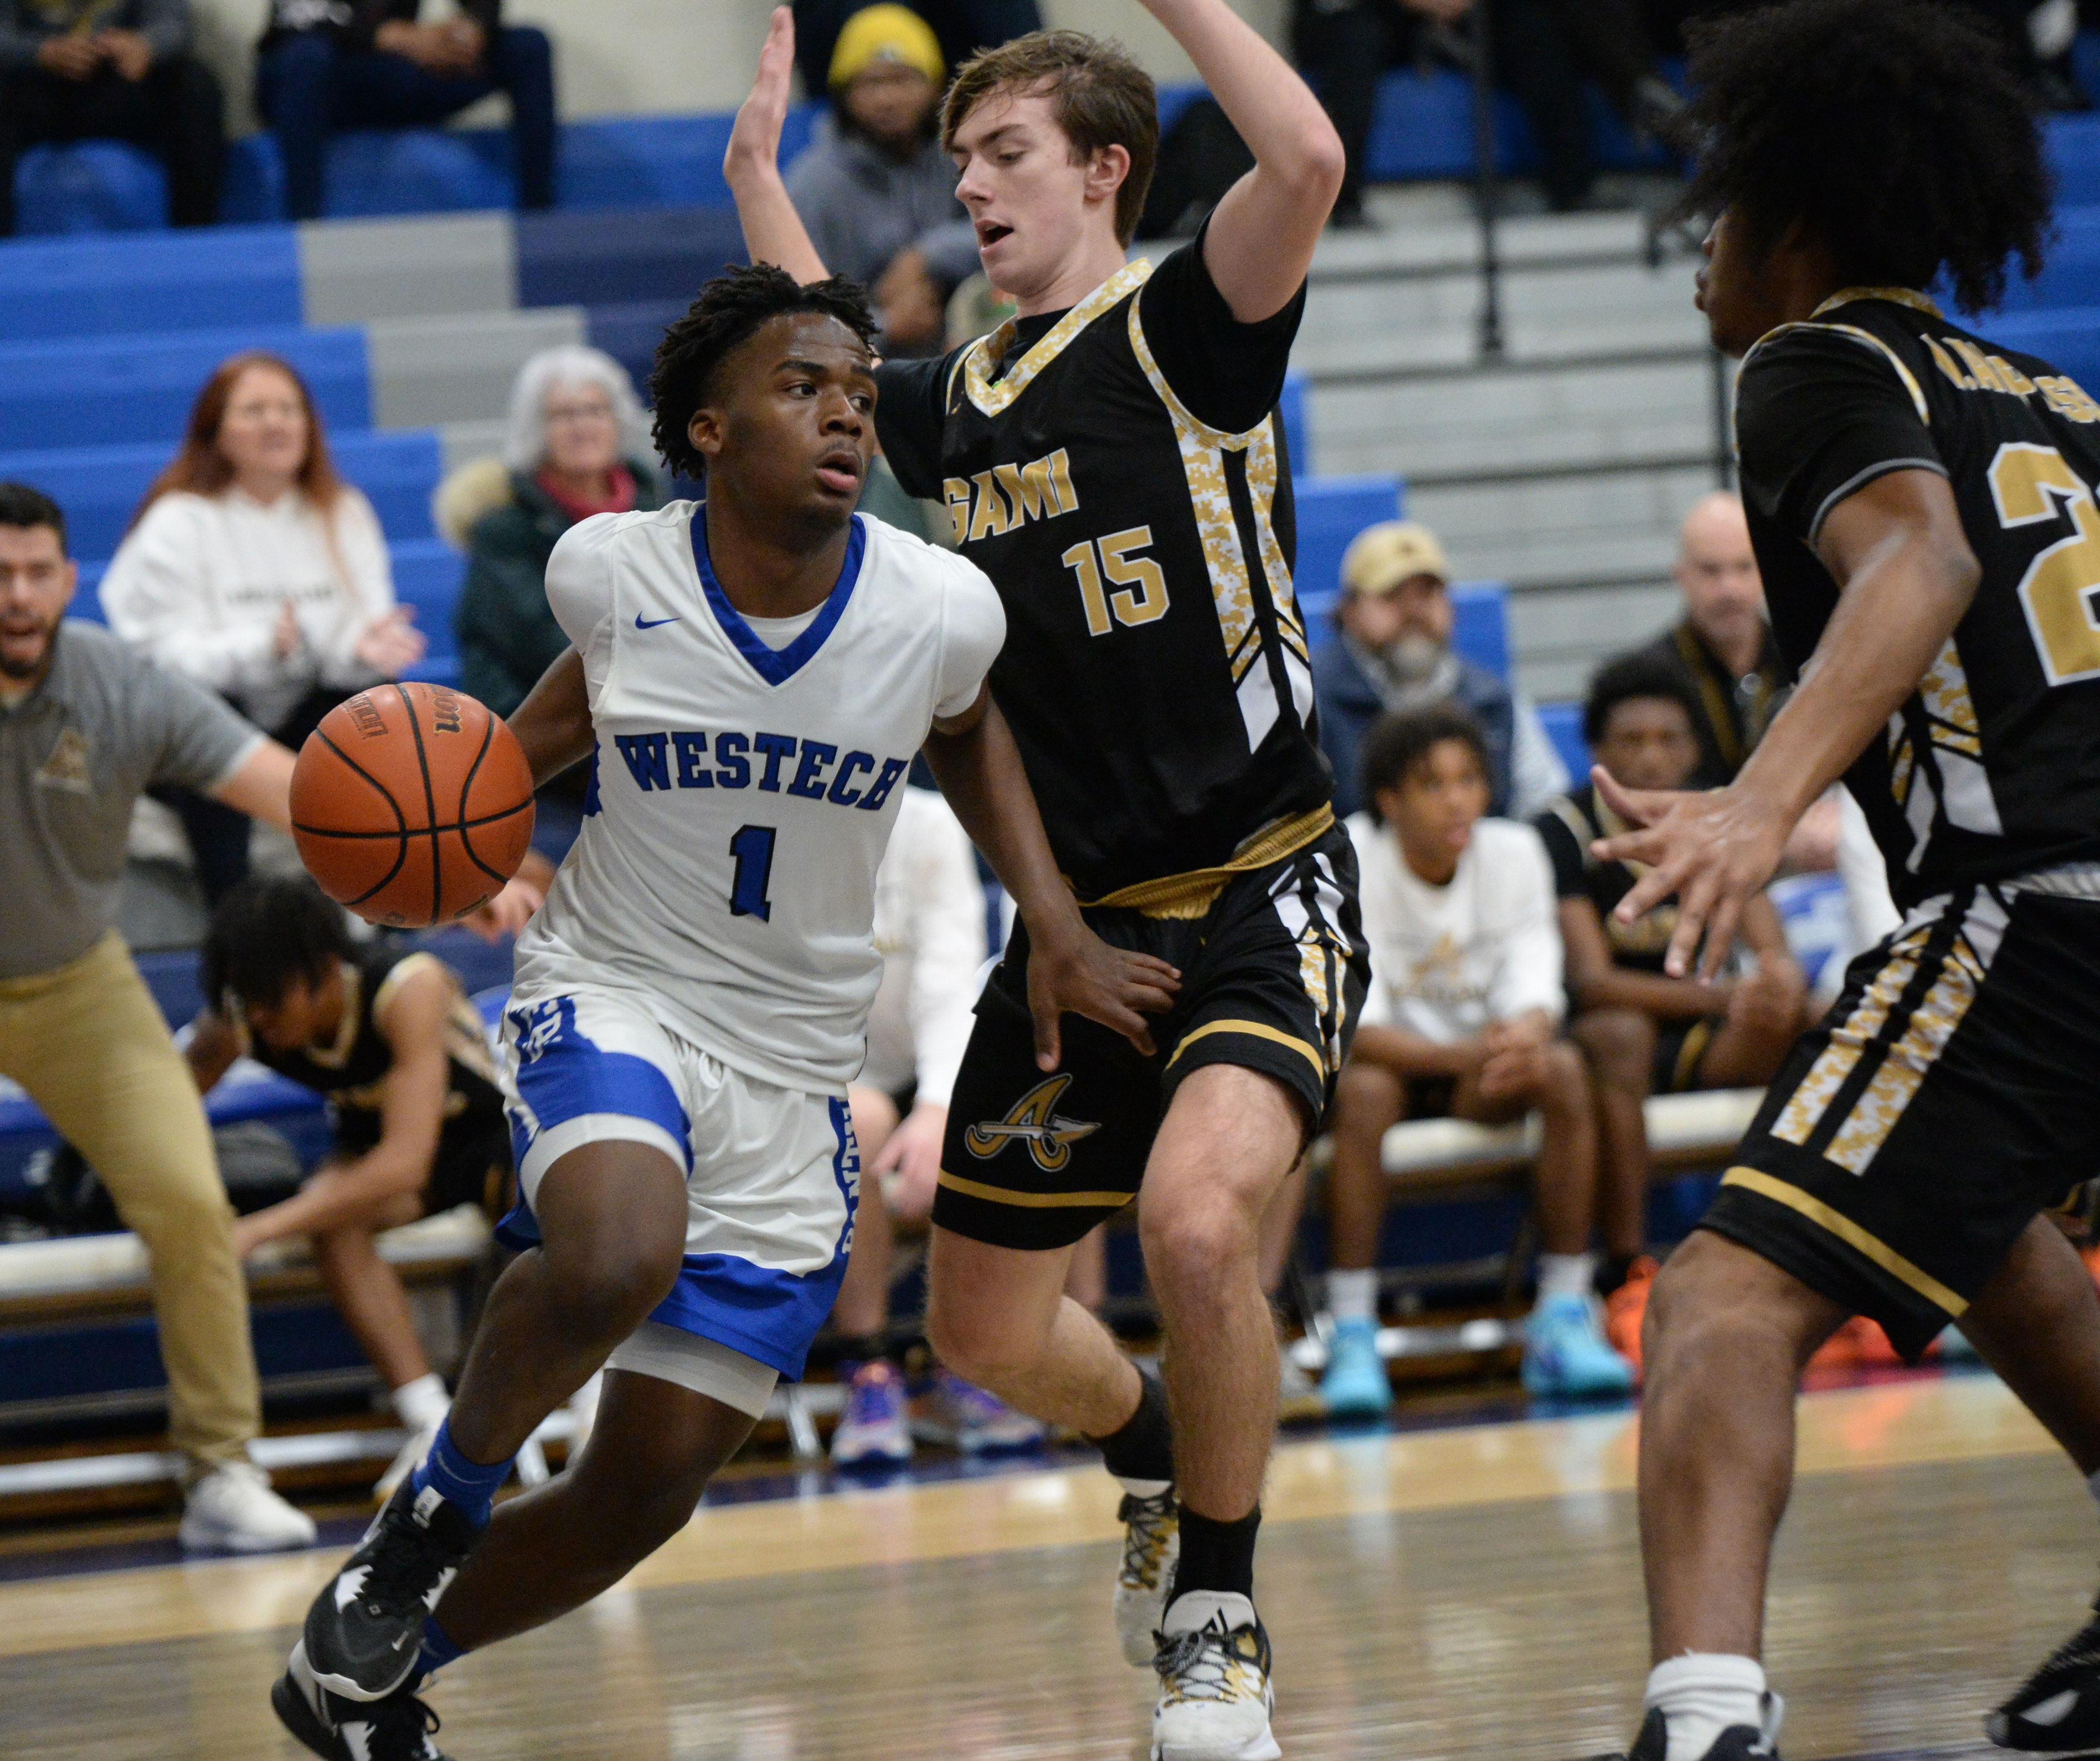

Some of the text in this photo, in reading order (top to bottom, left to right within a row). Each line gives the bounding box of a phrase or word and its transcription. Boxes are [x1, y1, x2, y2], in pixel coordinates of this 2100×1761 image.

[1061, 524, 1170, 637] 15
[1986, 442, 2100, 687] 2
[729, 823, 776, 923] 1
